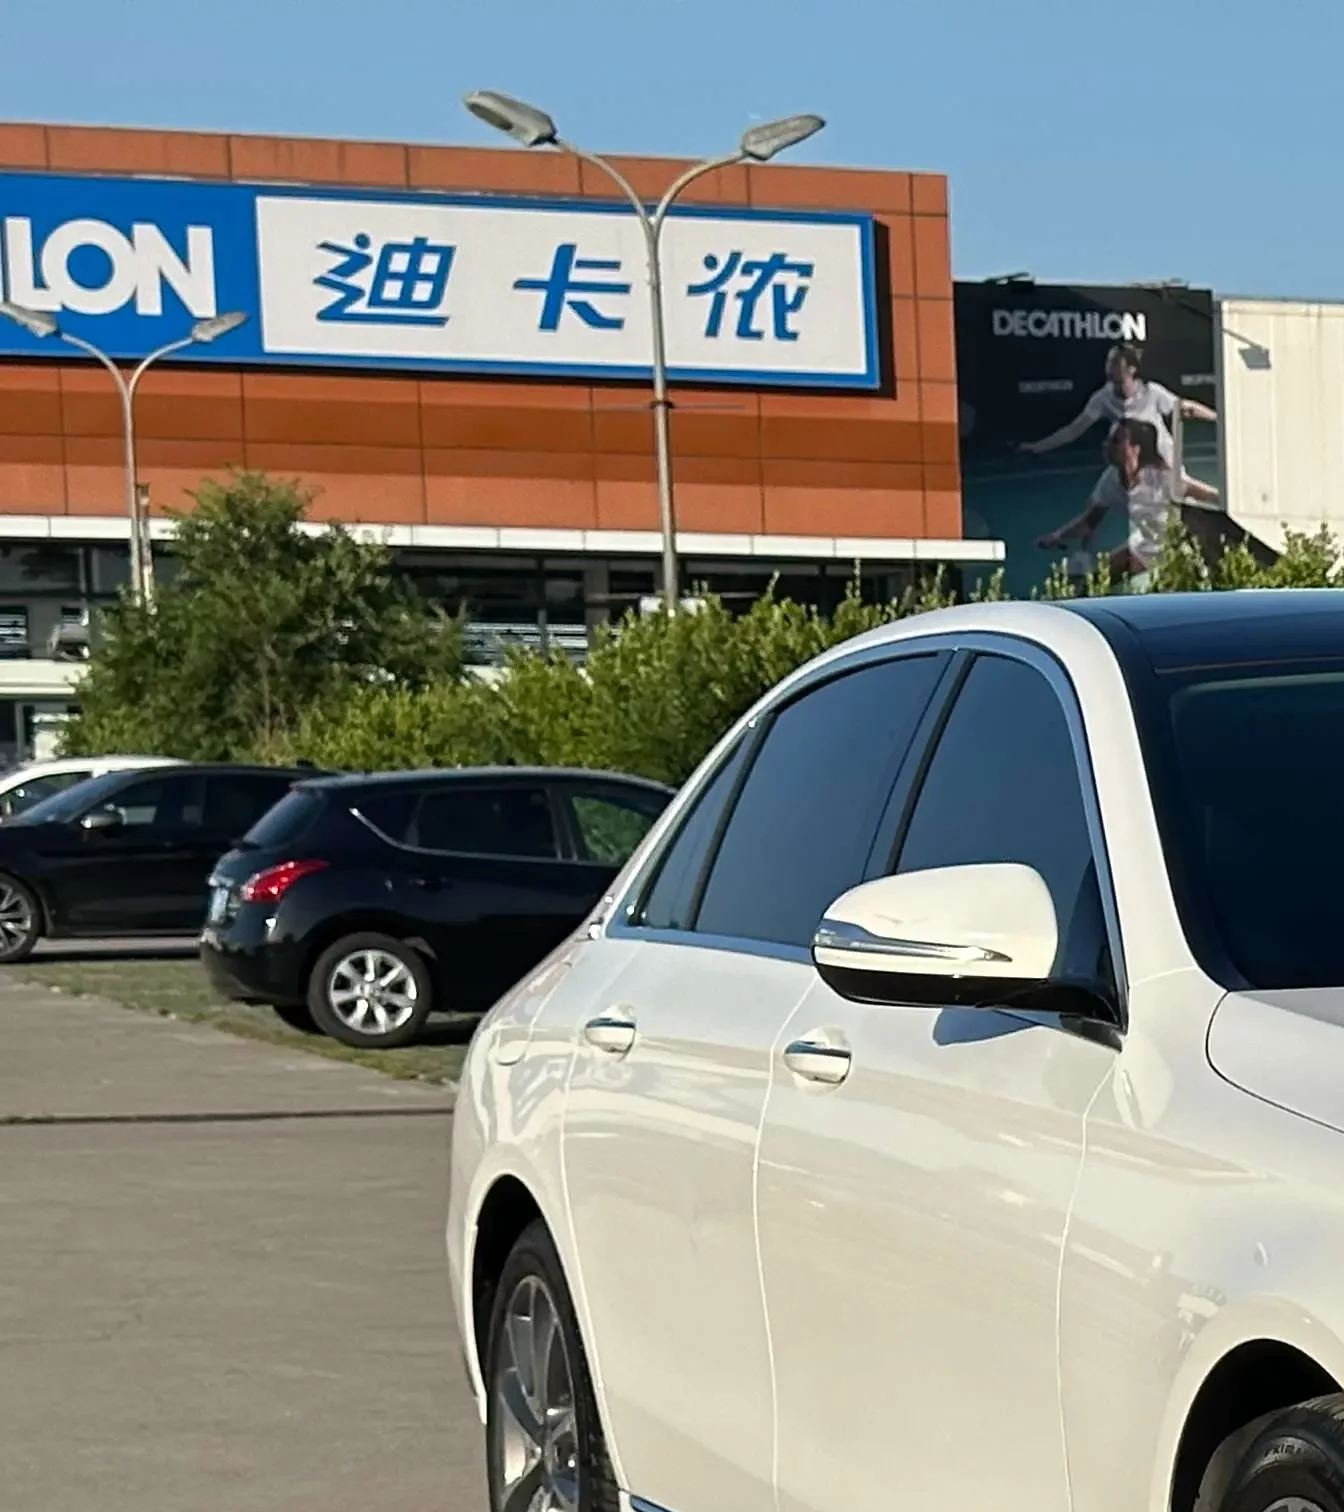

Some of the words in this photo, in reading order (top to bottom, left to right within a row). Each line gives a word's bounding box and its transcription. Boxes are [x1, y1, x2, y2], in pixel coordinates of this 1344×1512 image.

[0, 216, 217, 319] LON
[313, 232, 815, 341] 迪卡侬
[992, 308, 1147, 342] DECATHLON
